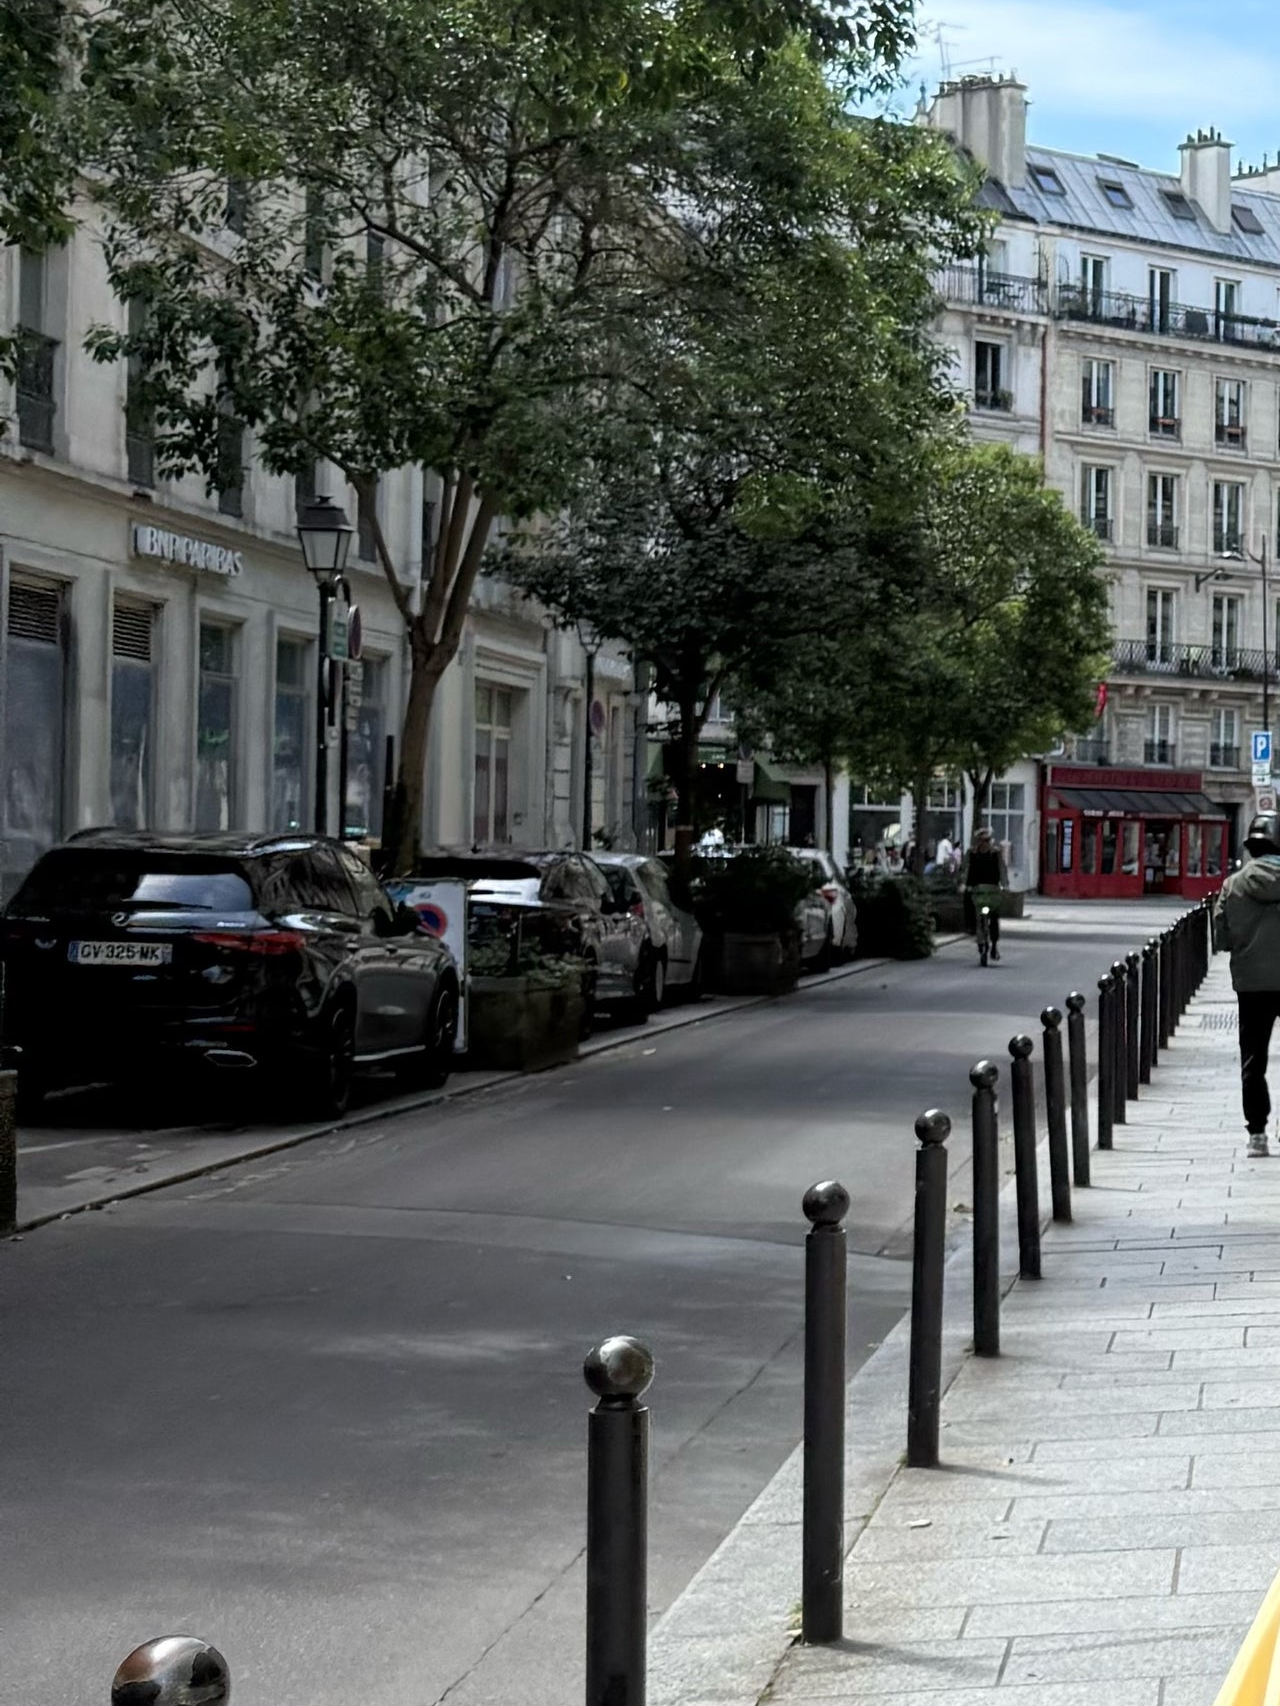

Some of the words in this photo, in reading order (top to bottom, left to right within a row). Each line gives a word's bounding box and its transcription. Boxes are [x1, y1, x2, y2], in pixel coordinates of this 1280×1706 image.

[146, 526, 180, 562] BNP
[182, 536, 243, 576] PARIBAS
[1256, 736, 1267, 759] P
